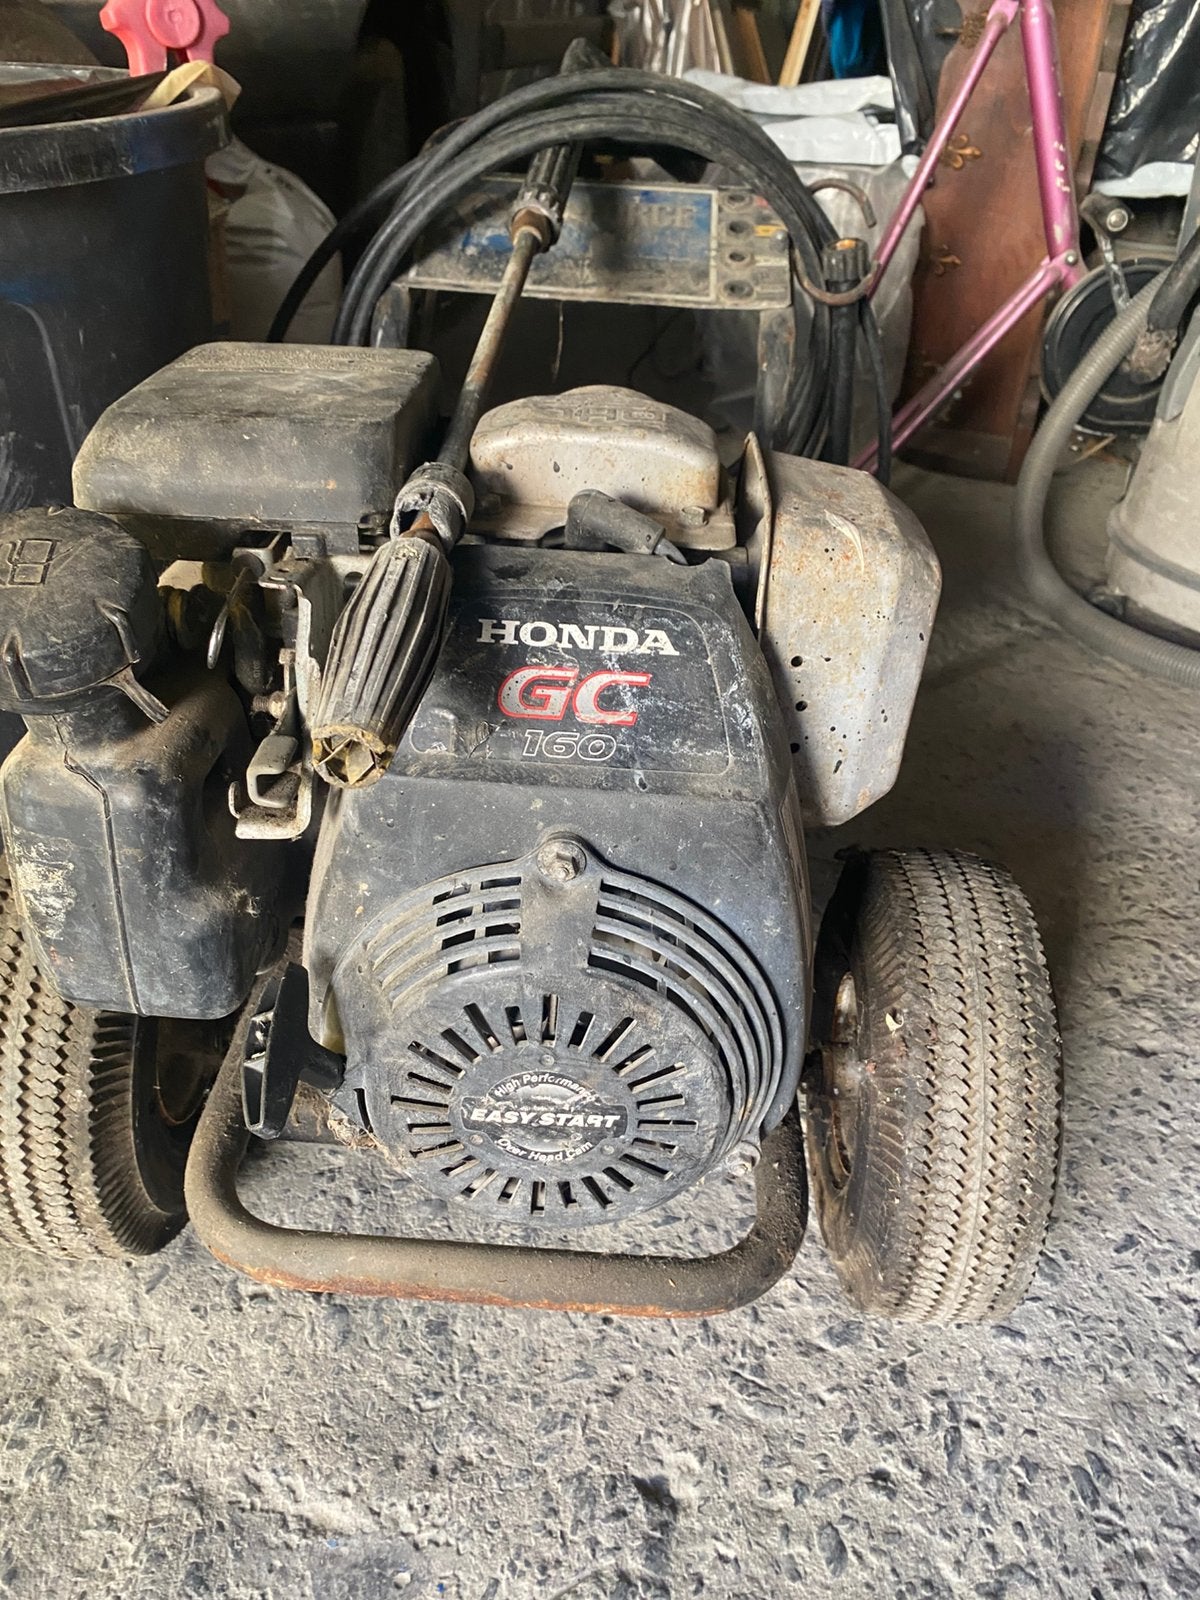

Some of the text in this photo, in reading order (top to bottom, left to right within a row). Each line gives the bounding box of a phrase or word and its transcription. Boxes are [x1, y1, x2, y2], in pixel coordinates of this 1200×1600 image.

[476, 618, 680, 656] HONDA
[498, 665, 652, 726] GC
[522, 729, 617, 761] 160
[494, 1078, 520, 1098] High
[470, 1108, 620, 1128] EASY START
[497, 1138, 593, 1161] Over Head Cam
